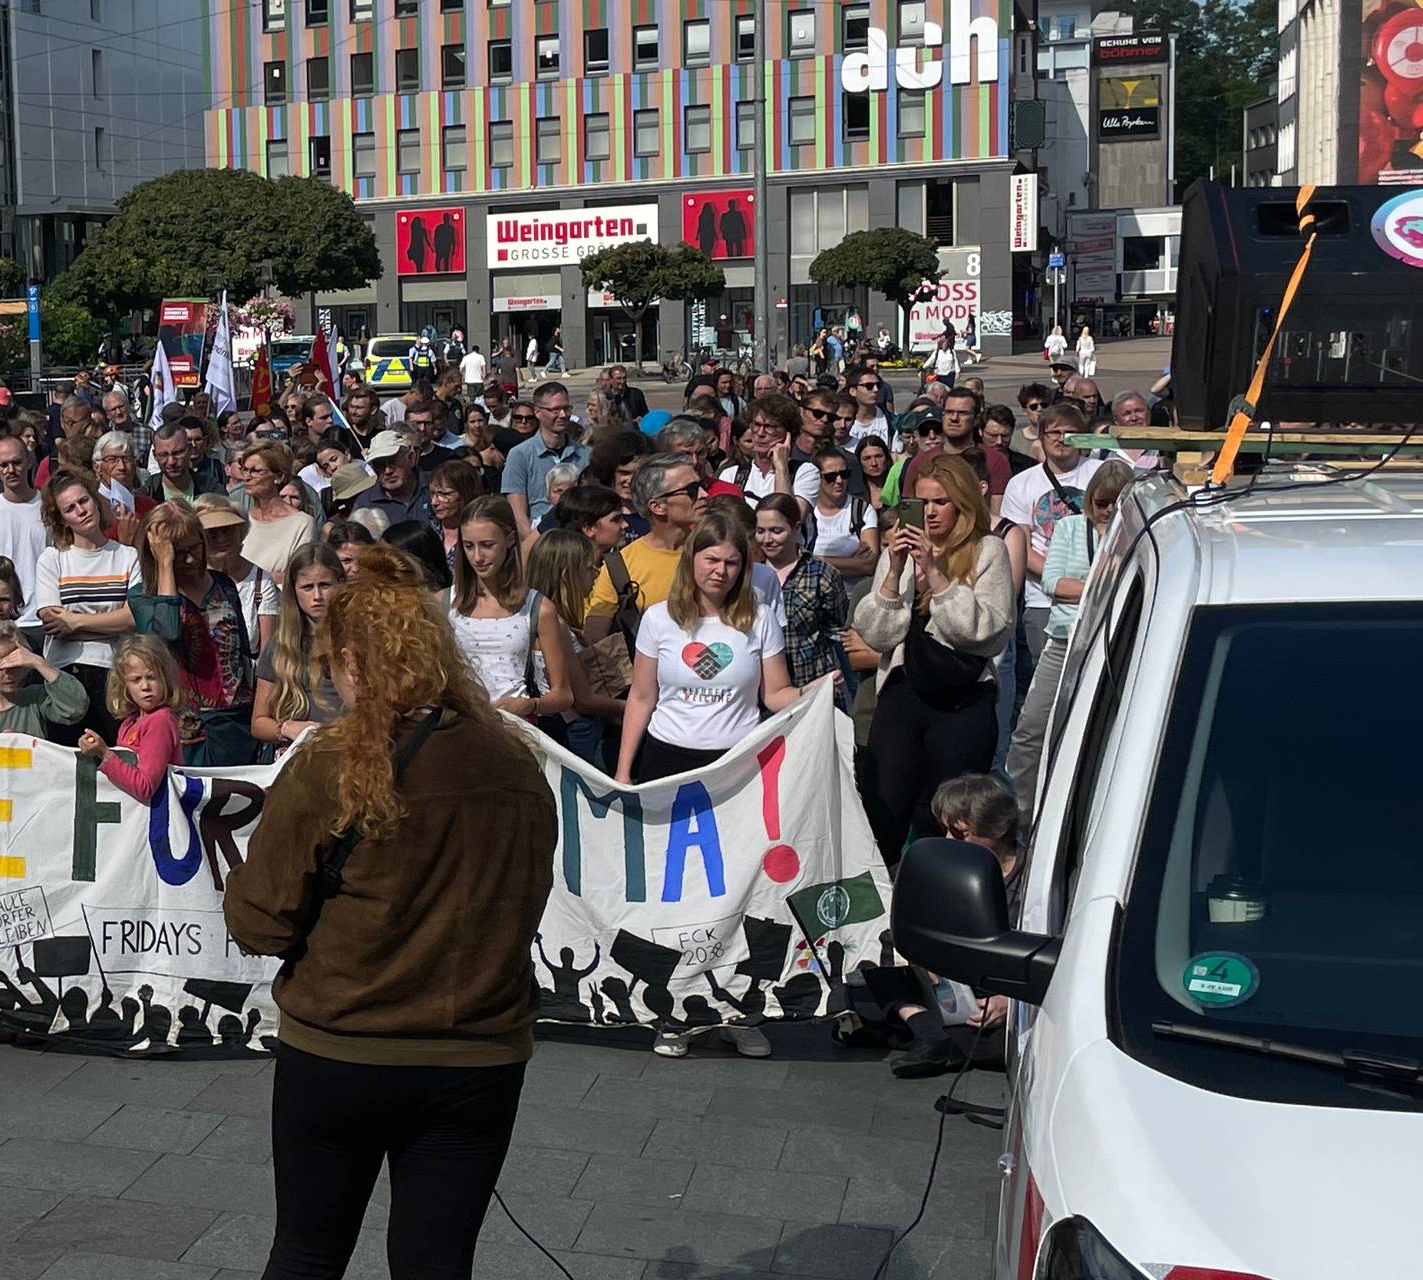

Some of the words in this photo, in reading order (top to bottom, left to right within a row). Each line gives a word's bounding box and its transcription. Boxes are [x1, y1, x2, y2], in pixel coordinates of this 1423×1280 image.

[1142, 36, 1162, 44] VON
[1014, 185, 1024, 248] Weingarten
[497, 216, 634, 245] Weingarten
[511, 247, 569, 261] GROSSE
[966, 253, 981, 276] 8
[102, 920, 202, 956] FRIDAYS
[678, 927, 719, 949] FCK
[1208, 959, 1229, 980] 4
